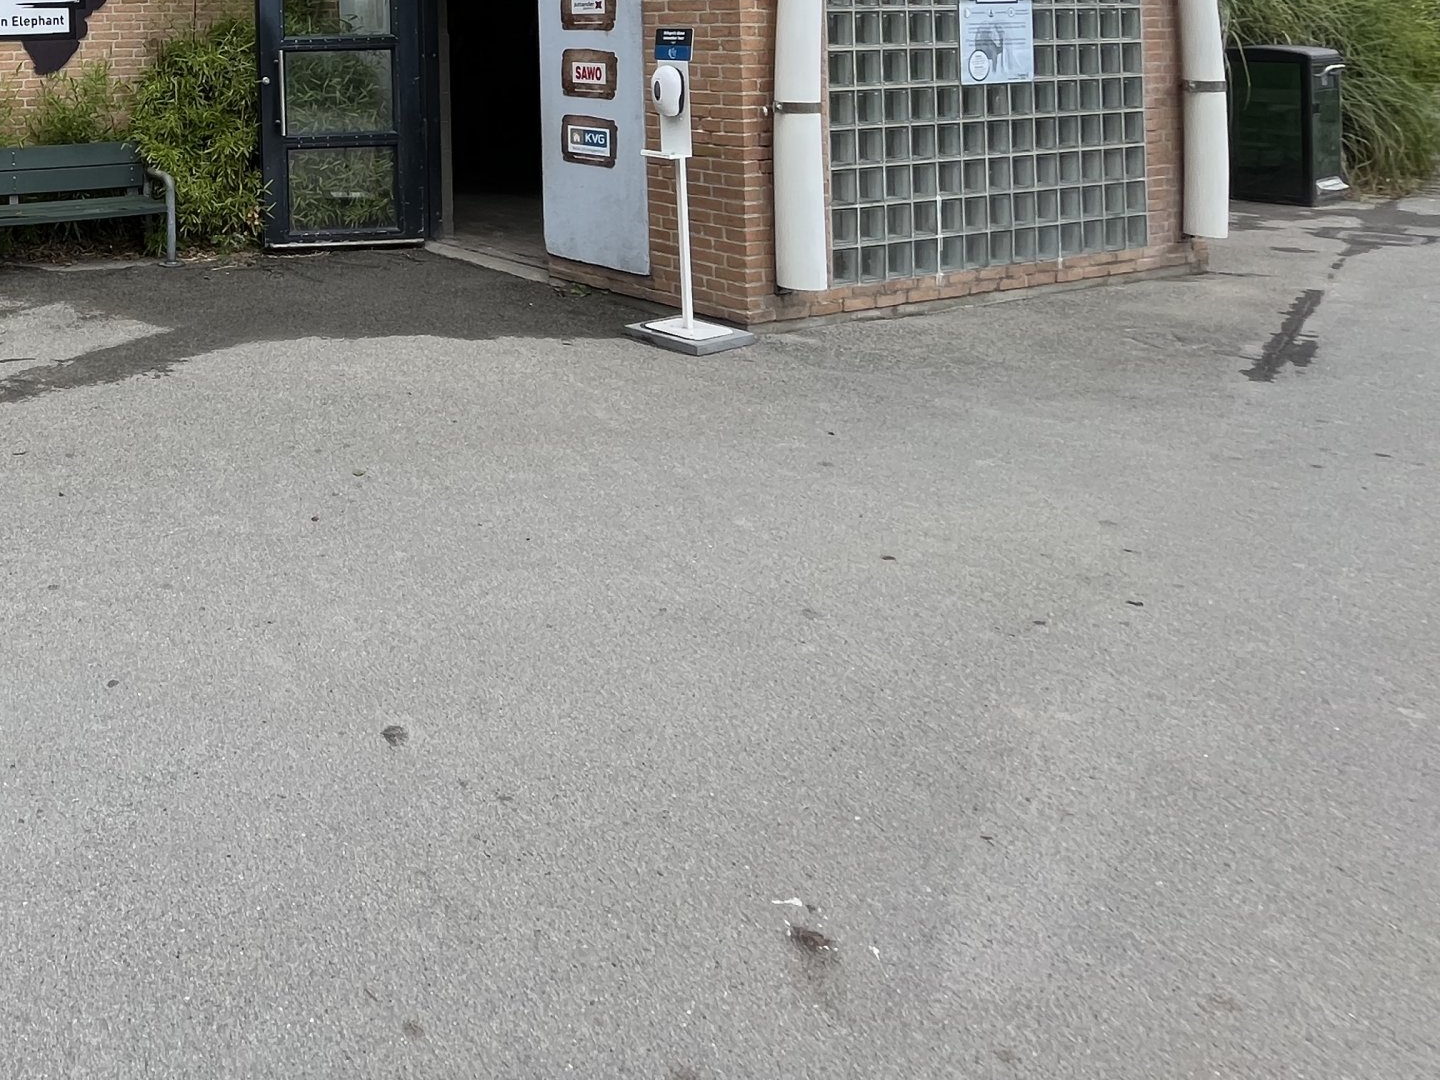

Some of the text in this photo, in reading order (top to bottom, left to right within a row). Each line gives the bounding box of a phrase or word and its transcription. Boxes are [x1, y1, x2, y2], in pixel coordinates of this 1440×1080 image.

[11, 14, 65, 29] Elephant
[575, 66, 602, 81] SAWO
[585, 132, 605, 145] KVG
